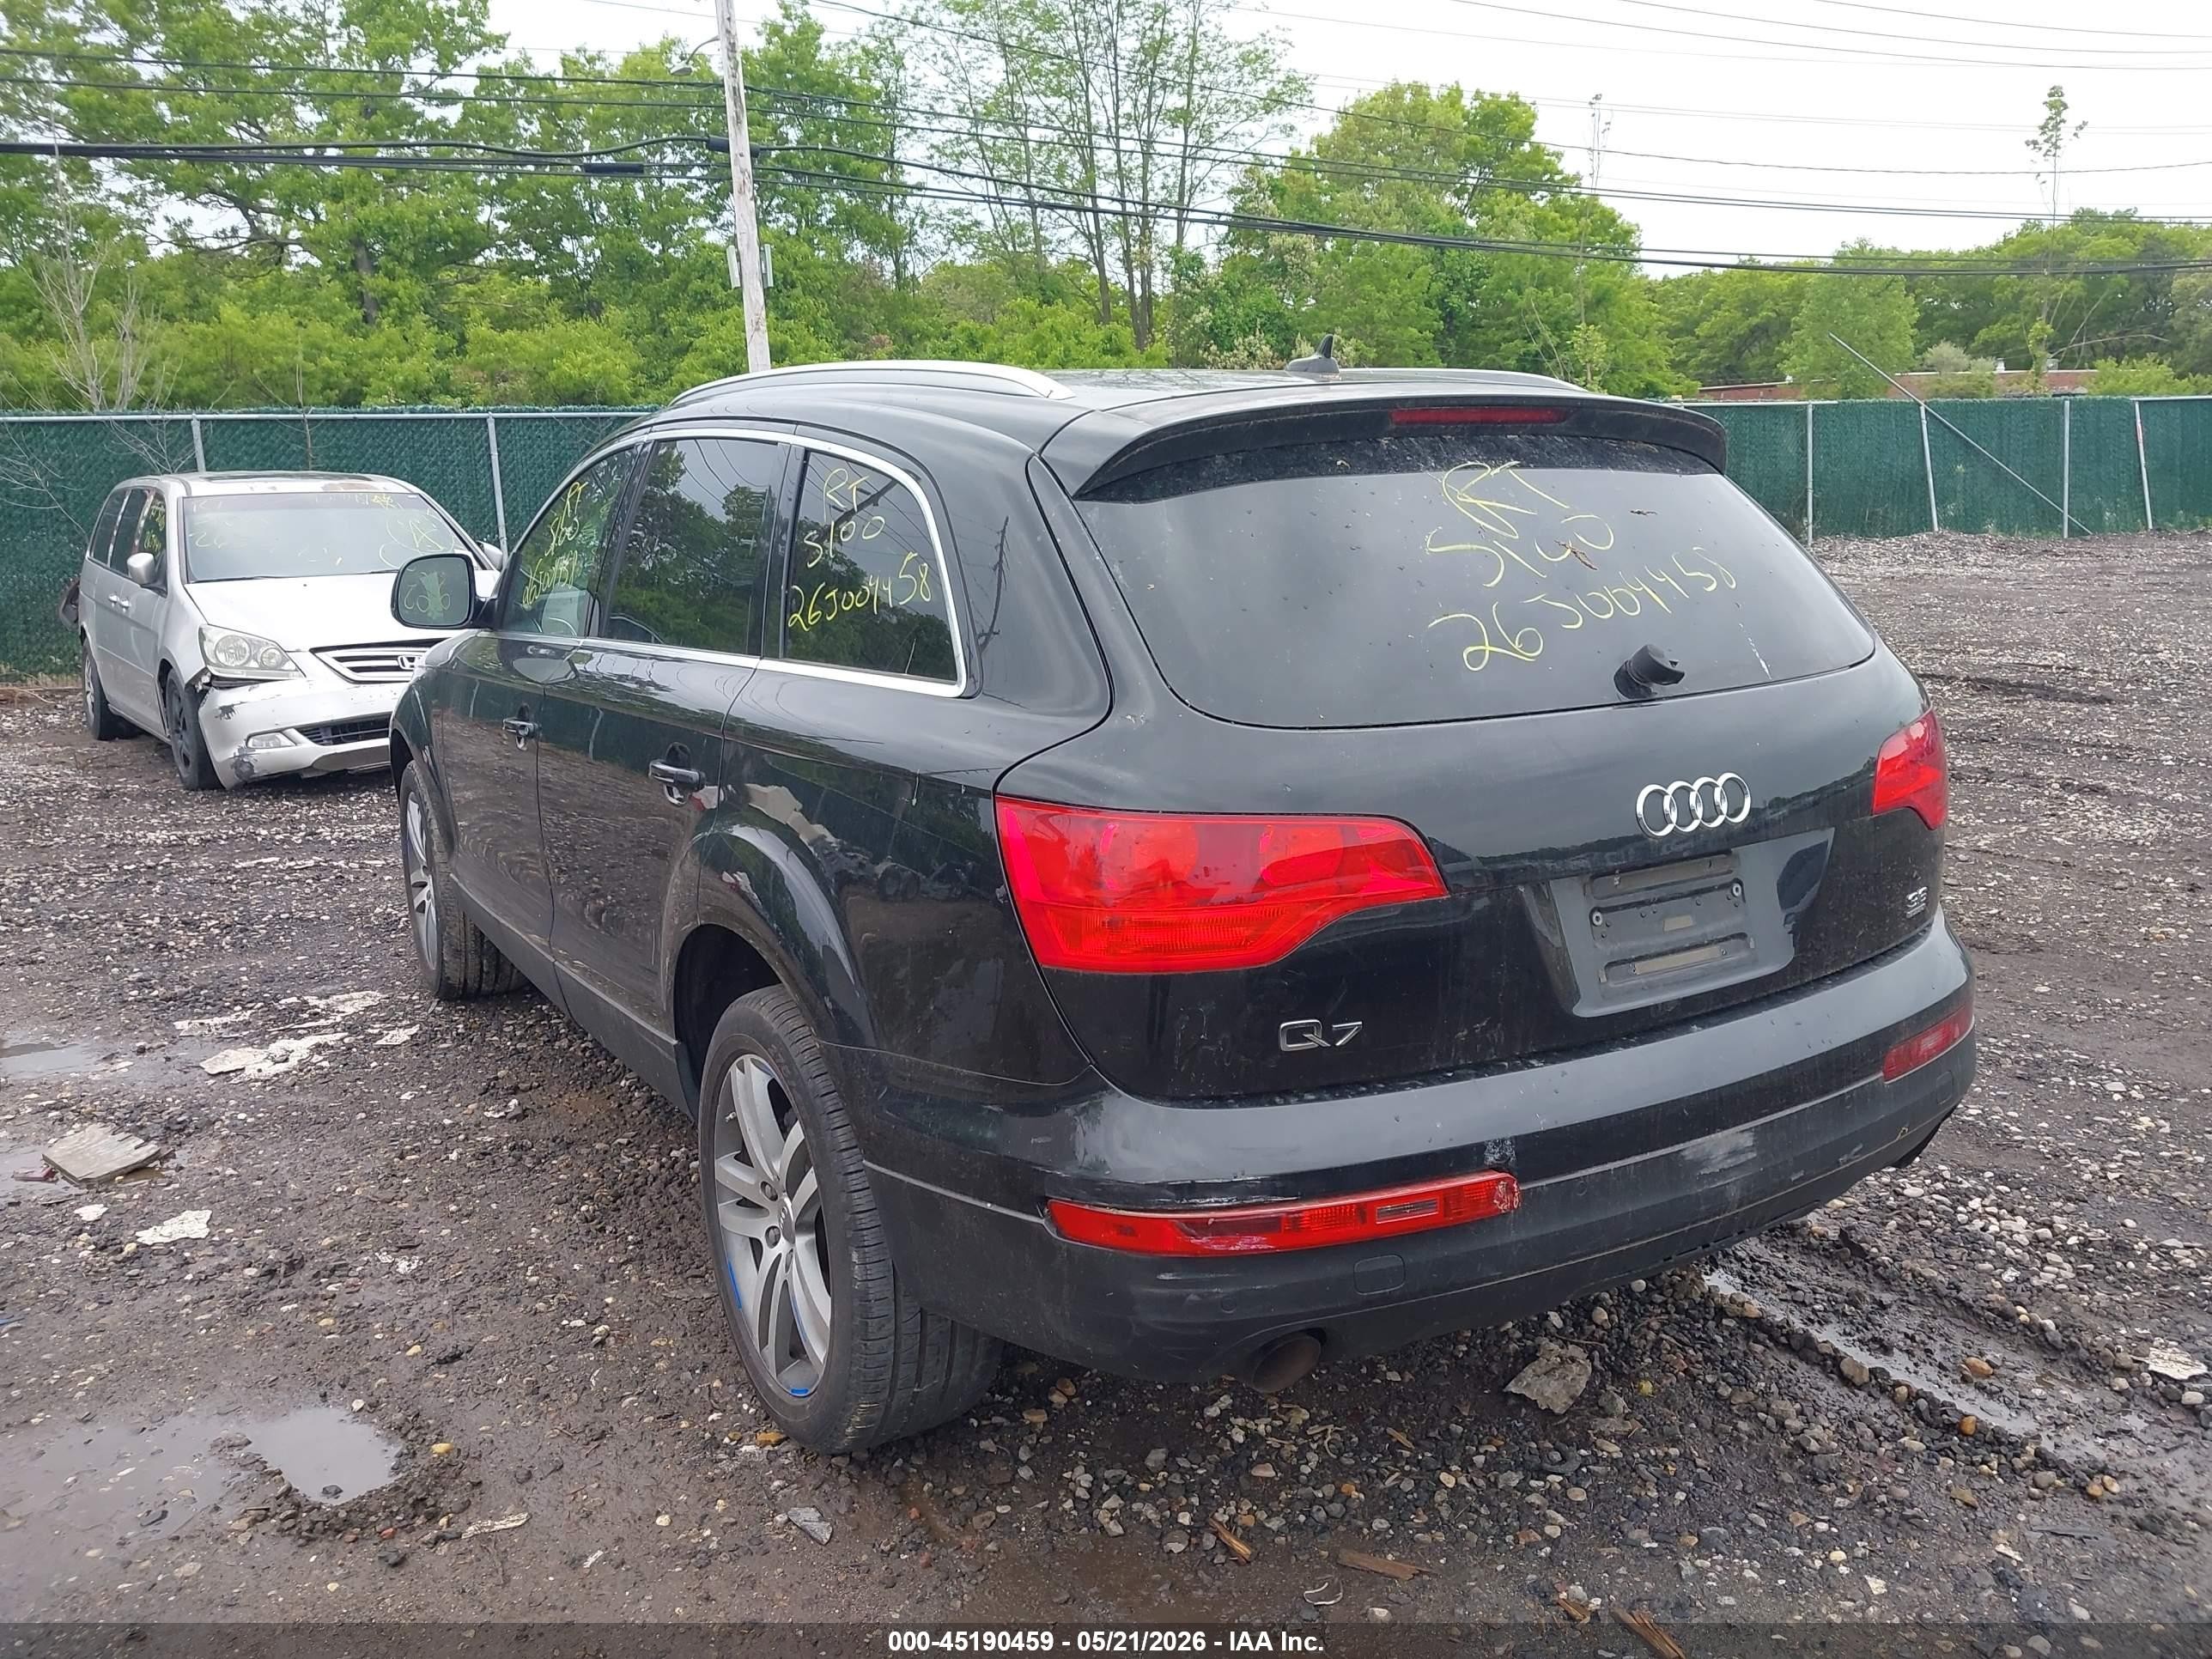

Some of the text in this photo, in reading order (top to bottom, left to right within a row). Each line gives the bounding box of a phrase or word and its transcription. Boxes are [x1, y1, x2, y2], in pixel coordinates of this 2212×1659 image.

[823, 468, 870, 522] RT
[803, 516, 885, 568] S100
[787, 552, 932, 632] 26J004458
[1427, 547, 1737, 672] 26J004458
[1279, 1018, 1363, 1052] Q7
